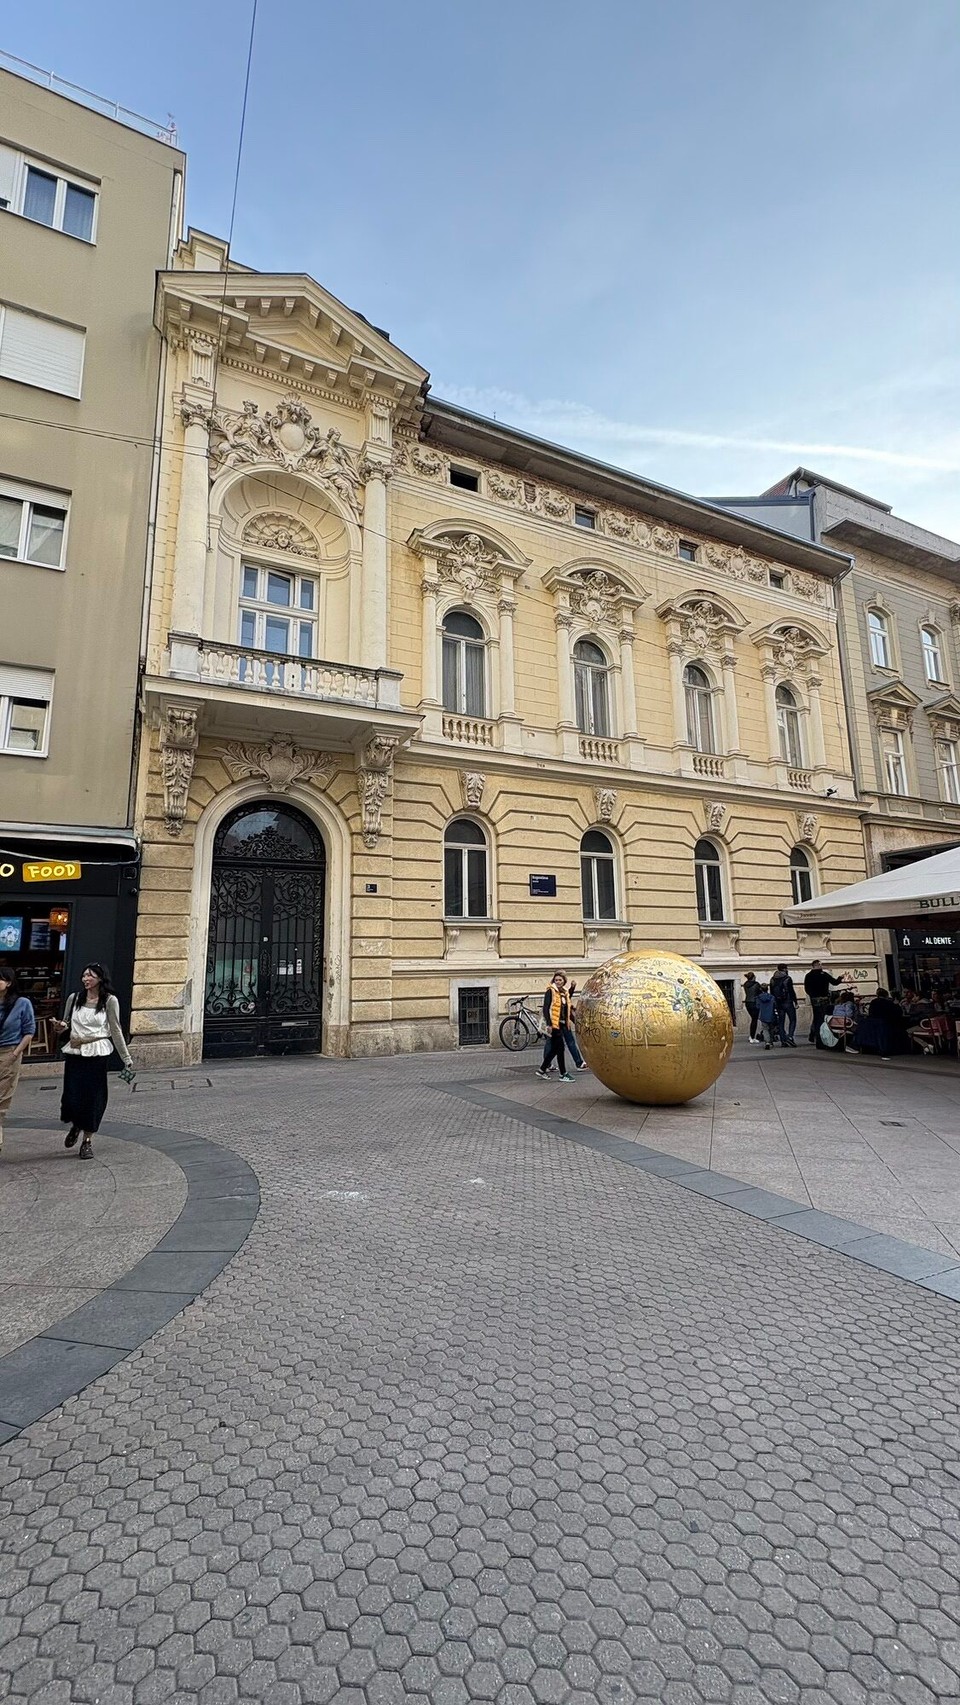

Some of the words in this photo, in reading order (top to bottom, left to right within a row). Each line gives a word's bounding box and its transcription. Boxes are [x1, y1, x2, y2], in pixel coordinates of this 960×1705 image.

[0, 863, 15, 877] O
[27, 863, 76, 878] FOOD
[919, 896, 960, 908] BULL
